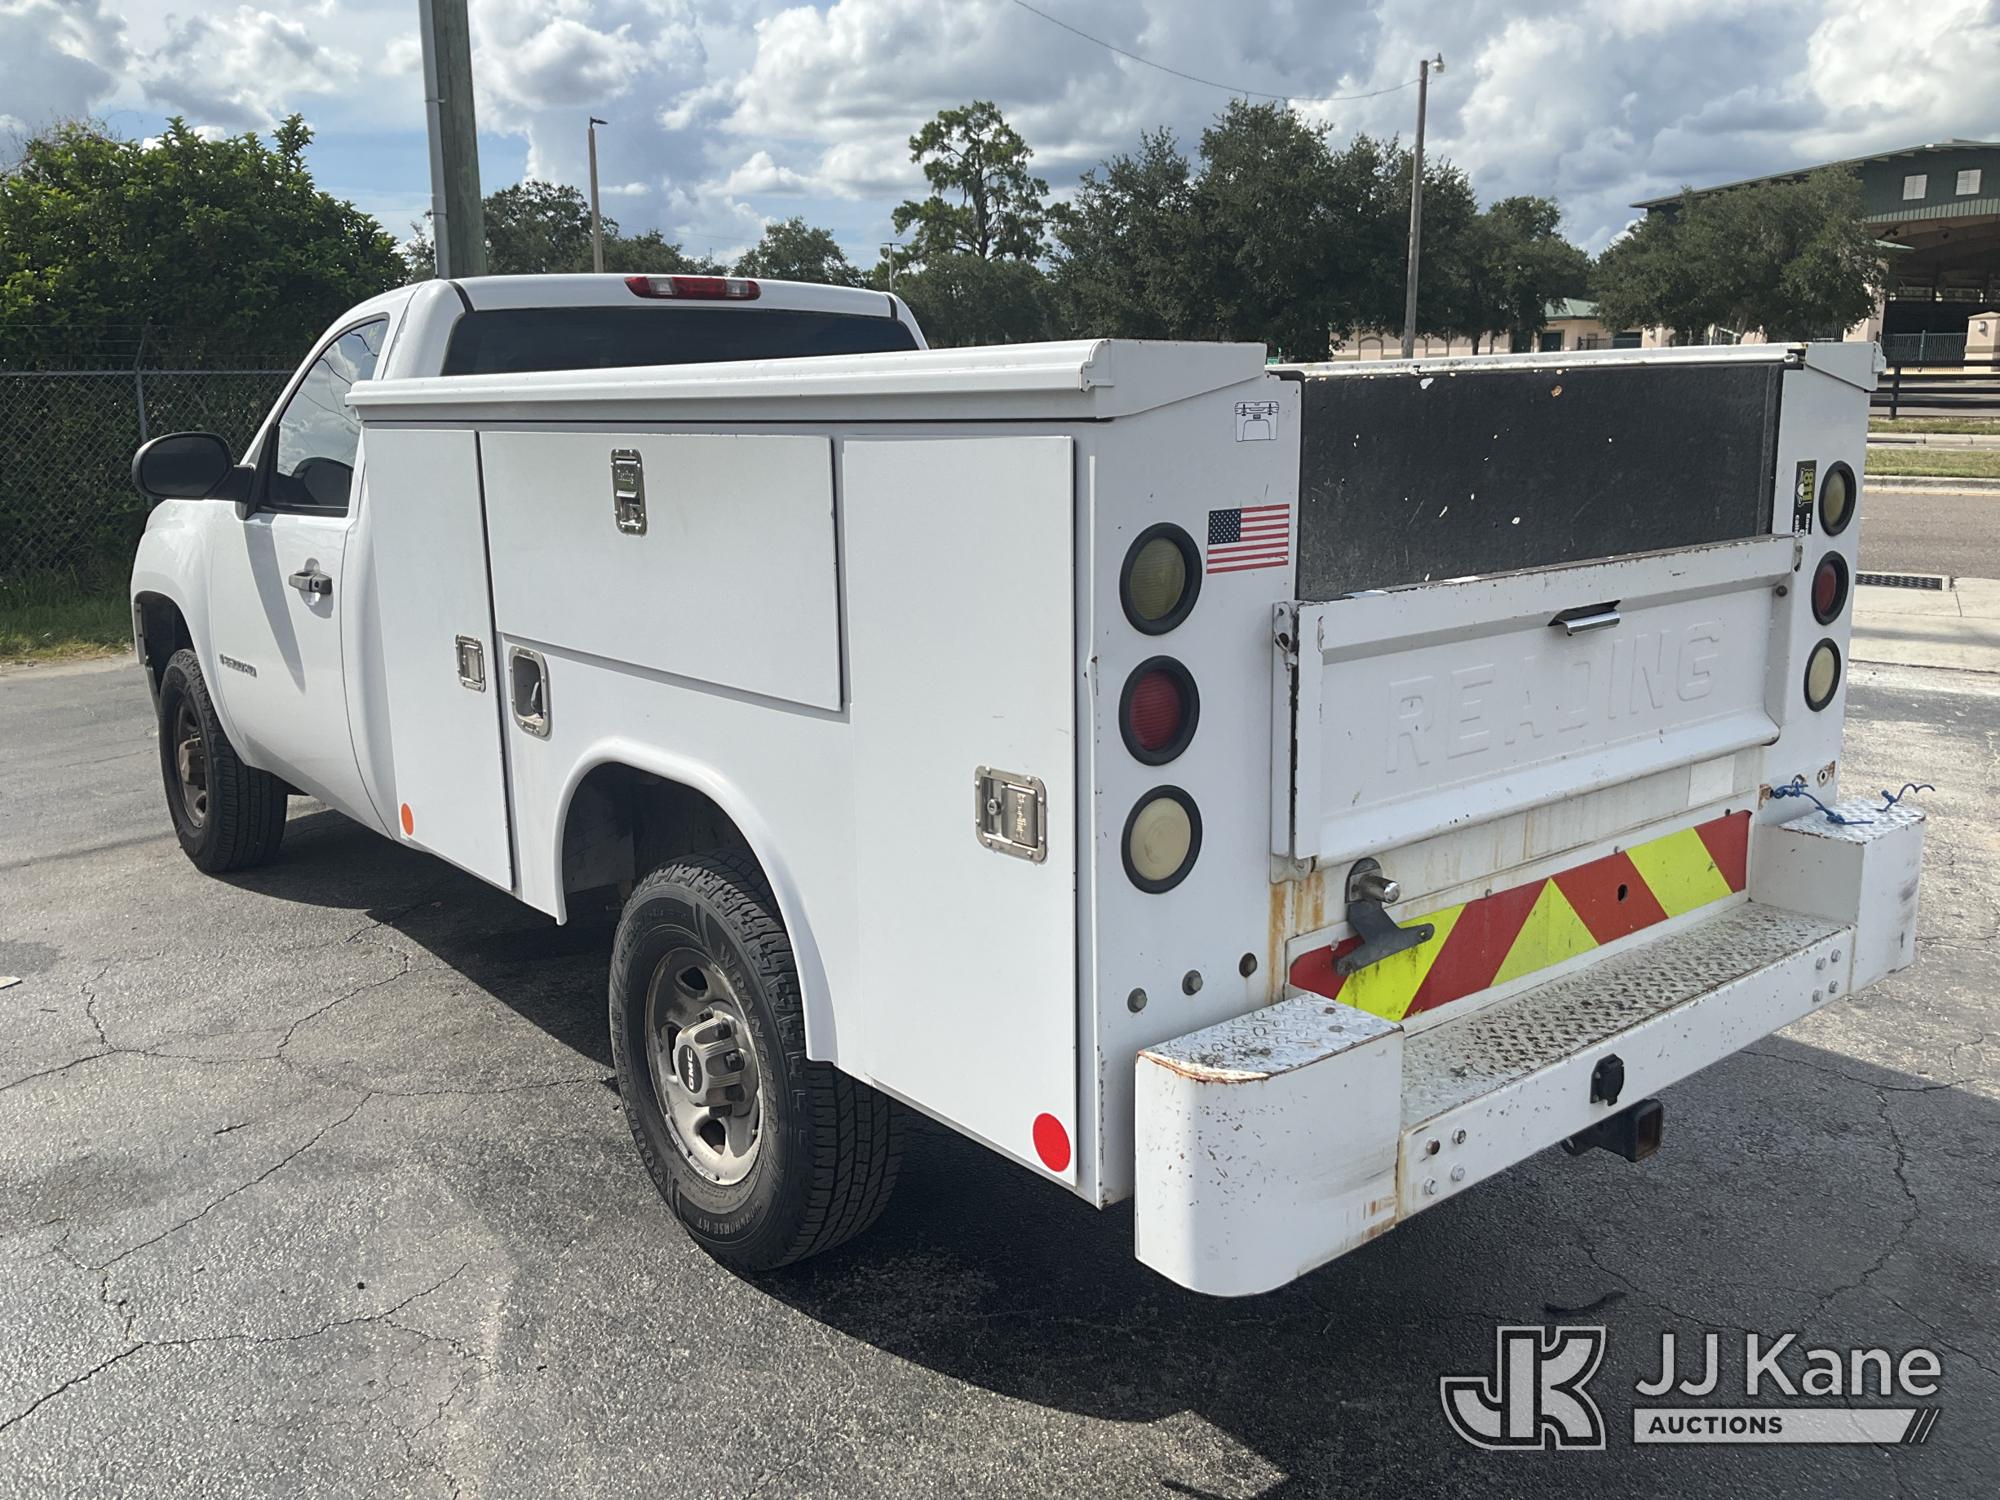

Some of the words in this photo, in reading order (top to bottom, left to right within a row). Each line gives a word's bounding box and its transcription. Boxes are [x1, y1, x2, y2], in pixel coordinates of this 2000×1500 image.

[1803, 470, 1814, 501] 811
[1385, 620, 1720, 775] READING
[686, 1047, 695, 1091] GMC
